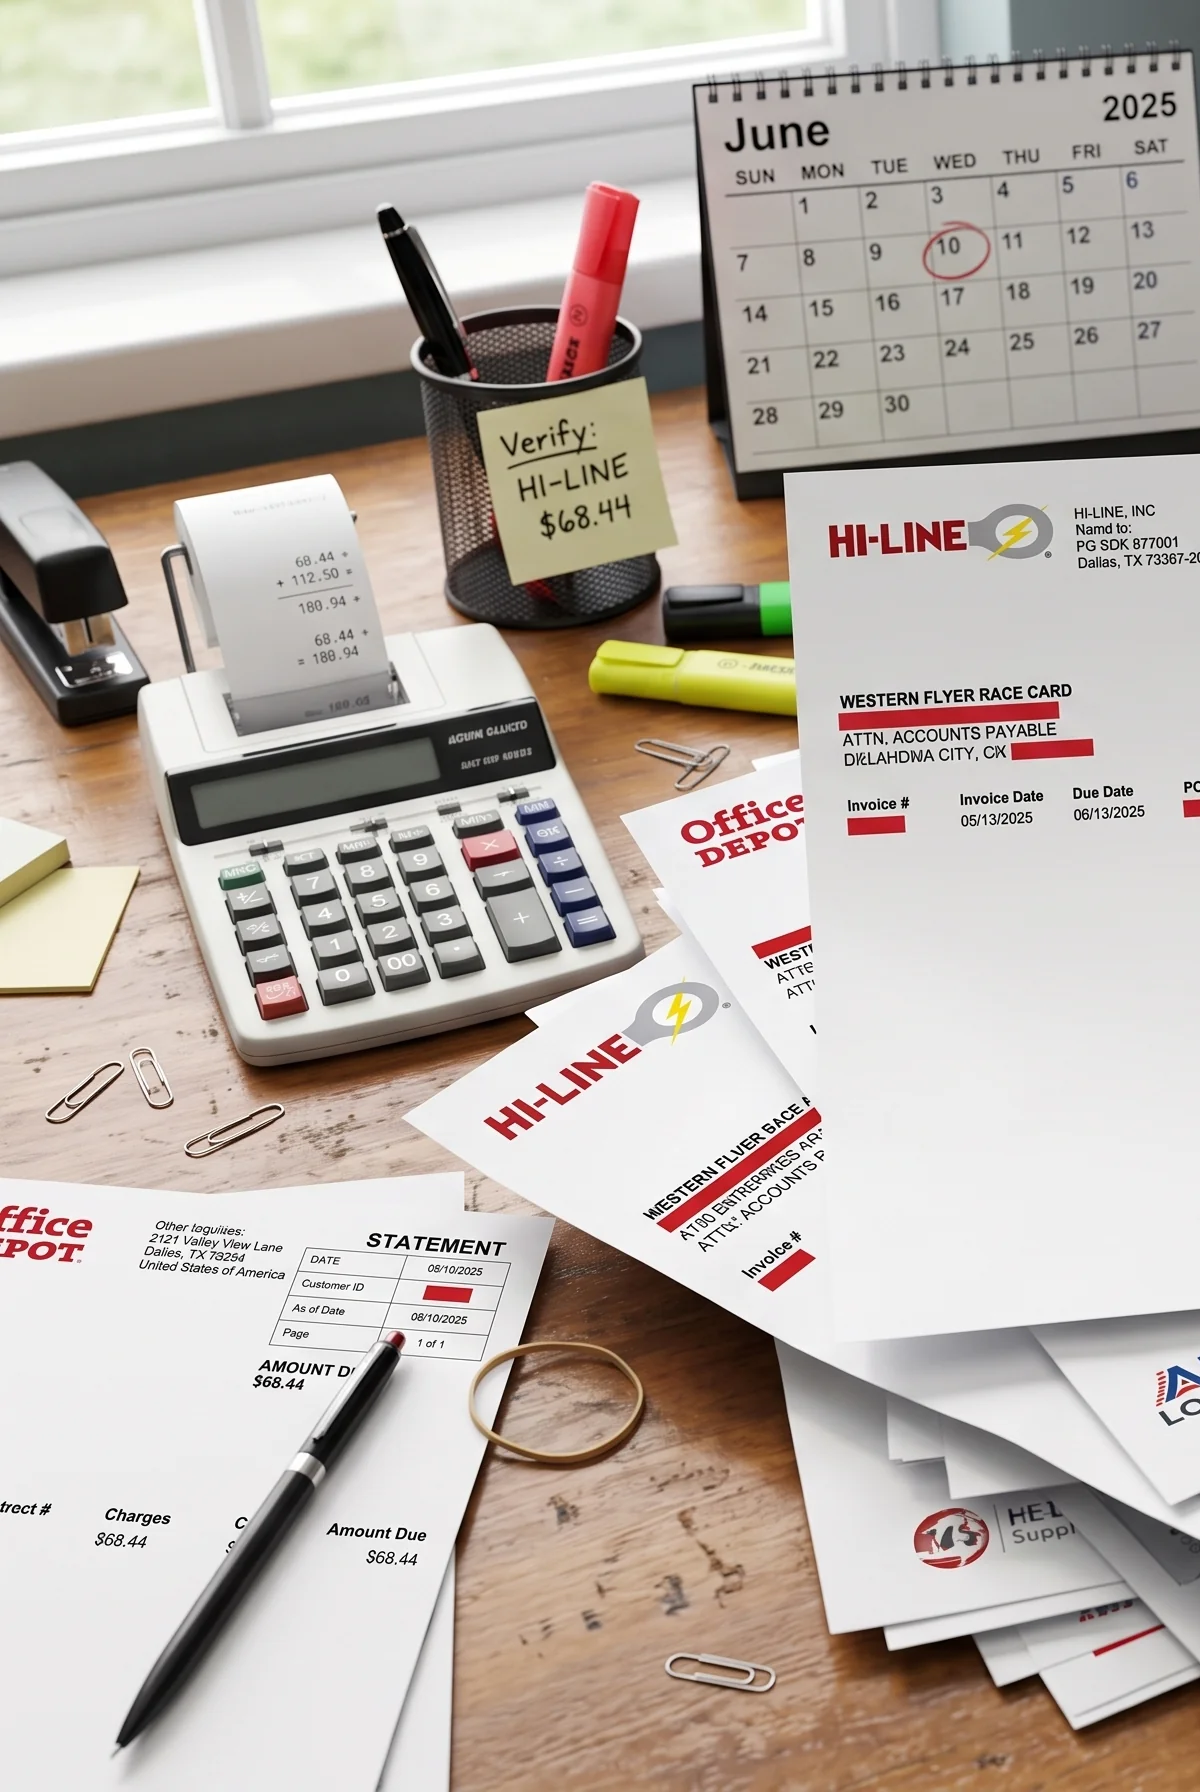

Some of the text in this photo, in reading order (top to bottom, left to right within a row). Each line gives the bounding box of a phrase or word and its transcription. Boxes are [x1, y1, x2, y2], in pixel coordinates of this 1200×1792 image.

[1104, 92, 1176, 121] 2025
[725, 118, 829, 152] June
[736, 139, 1167, 185] SUN MON TUE WED THU FRI SAT
[936, 221, 1154, 254] 10 11 12 13
[744, 271, 1157, 322] 14 15 16 17 18 19 20
[748, 321, 1160, 374] 21 22 23 24 25 26 27
[753, 395, 909, 425] 28 29 30
[501, 420, 598, 456] Verify:
[518, 453, 628, 502] HI-LINE
[540, 494, 630, 540] $68.44
[1074, 504, 1155, 519] HI-LINE, INC
[1115, 522, 1132, 534] to:
[828, 520, 967, 558] HI-LINE
[1076, 539, 1096, 552] PG
[1132, 535, 1178, 550] 877001
[296, 551, 334, 567] 68.44
[1123, 554, 1143, 566] TX
[292, 568, 339, 586] 112.50
[315, 629, 354, 646] 68.44
[839, 683, 1072, 709] WESTERN FLYER RACE CARD
[842, 721, 1057, 747] ATTN. ACCOUNTS PAYABLE
[938, 746, 978, 762] CITY,
[959, 790, 1044, 806] Invoice Date
[1072, 785, 1133, 799] Due Date
[847, 798, 897, 812] Invoice
[1073, 804, 1145, 821] 06/13/2025
[681, 795, 803, 844] Office
[960, 811, 1033, 827] 05/13/2025
[413, 854, 427, 865] 9
[360, 865, 374, 877] 8
[307, 876, 319, 889] 7
[426, 883, 440, 896] 6
[372, 894, 386, 907] 5
[318, 908, 332, 918] 4
[437, 913, 452, 925] 3
[382, 926, 398, 939] 2
[330, 938, 340, 950] 1
[335, 969, 350, 981] 0
[484, 1033, 643, 1140] HI-LINE
[740, 1162, 817, 1219] ACCOUNTS
[0, 1205, 92, 1238] ffice
[366, 1232, 507, 1256] STATEMENT
[310, 1255, 341, 1265] DATE
[139, 1260, 286, 1280] United States America
[301, 1278, 364, 1291] Customer ID
[320, 1305, 345, 1316] Date
[282, 1327, 309, 1340] Page
[258, 1359, 335, 1376] AMOUNT
[252, 1374, 305, 1390] $68.44
[104, 1507, 171, 1527] Charges
[94, 1532, 147, 1548] $68.44
[326, 1522, 427, 1542] Amount Due
[365, 1549, 418, 1566] $68.44
